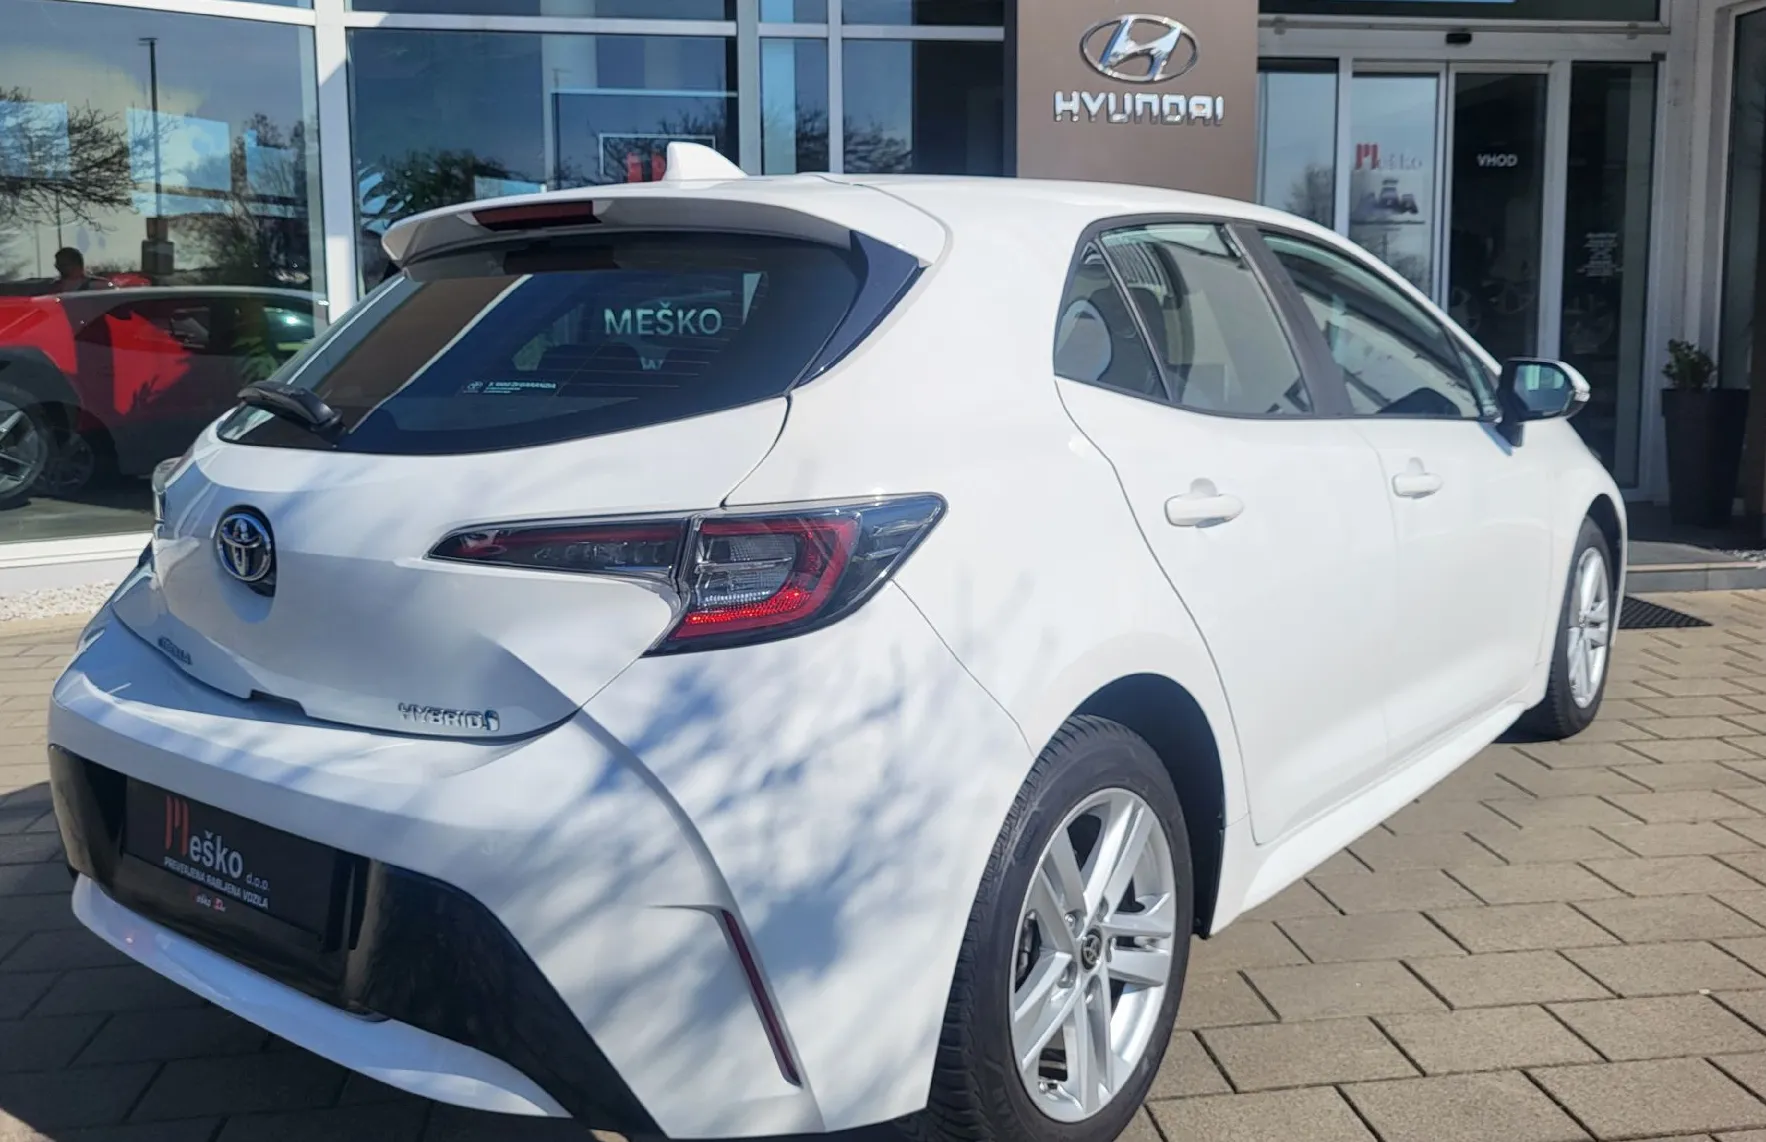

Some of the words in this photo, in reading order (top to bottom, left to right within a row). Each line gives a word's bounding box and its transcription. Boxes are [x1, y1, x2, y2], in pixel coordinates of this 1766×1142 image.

[1053, 90, 1224, 126] HYUNDAI
[1477, 153, 1518, 168] VHOD
[604, 301, 722, 335] MEŠKO
[398, 702, 485, 729] HYBRID
[165, 795, 243, 879] Meško
[243, 889, 269, 910] VOZILA
